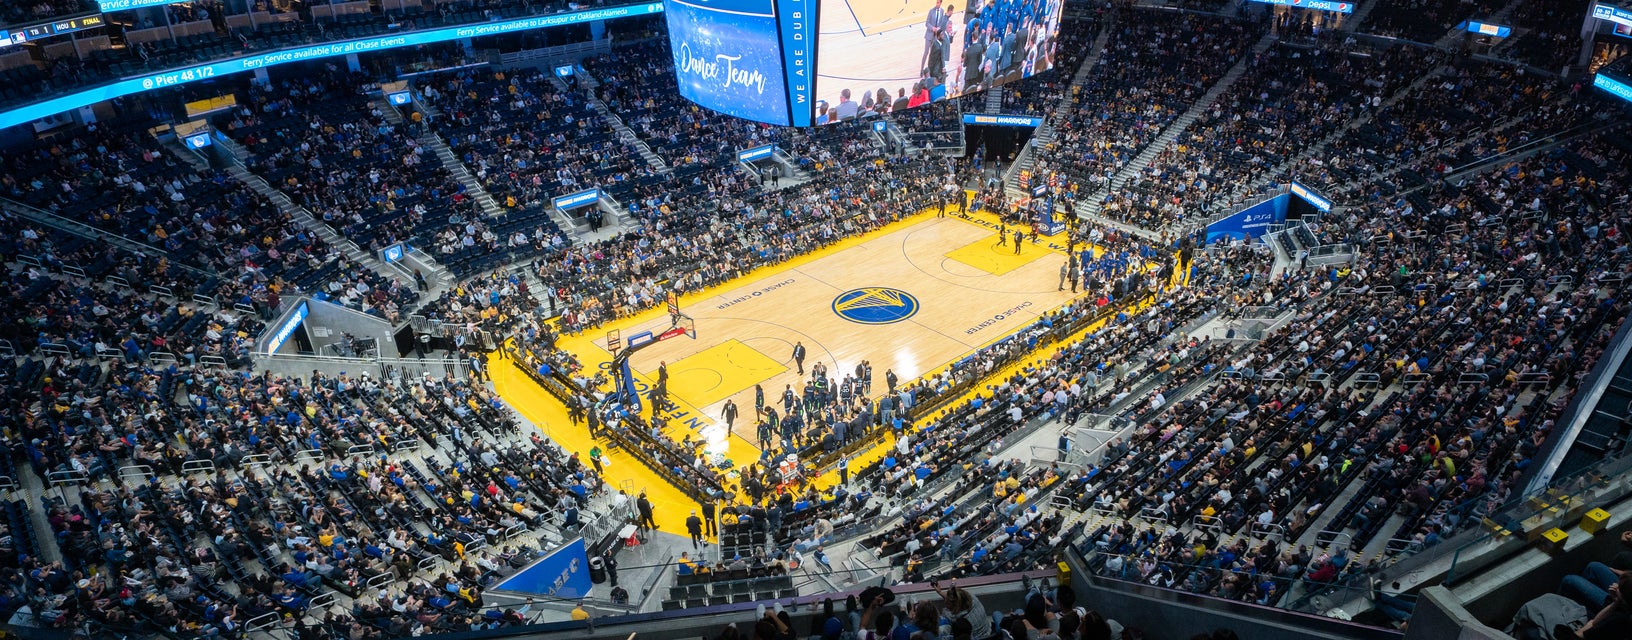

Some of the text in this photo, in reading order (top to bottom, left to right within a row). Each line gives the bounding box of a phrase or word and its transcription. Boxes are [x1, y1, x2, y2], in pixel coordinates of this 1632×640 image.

[1308, 1, 1331, 9] pepsi
[43, 26, 48, 34] 1
[56, 23, 69, 31] HOU
[83, 17, 100, 26] FINAL
[457, 28, 475, 37] Ferry
[476, 24, 500, 34] Service
[500, 21, 529, 31] available
[577, 8, 628, 20] Oakland-Alameda
[792, 11, 803, 40] DUB
[142, 36, 406, 89] @ Pier 48 1/2 Ferry Service available for all Chase Events
[680, 41, 767, 95] Dance Team
[794, 49, 805, 77] ARE
[796, 84, 806, 104] WE
[997, 117, 1032, 125] WARRIORS
[1254, 213, 1272, 221] PS4
[717, 278, 796, 310] CHASE CENTER
[964, 301, 1033, 335] CHASE CENTER
[548, 568, 571, 596] ASE
